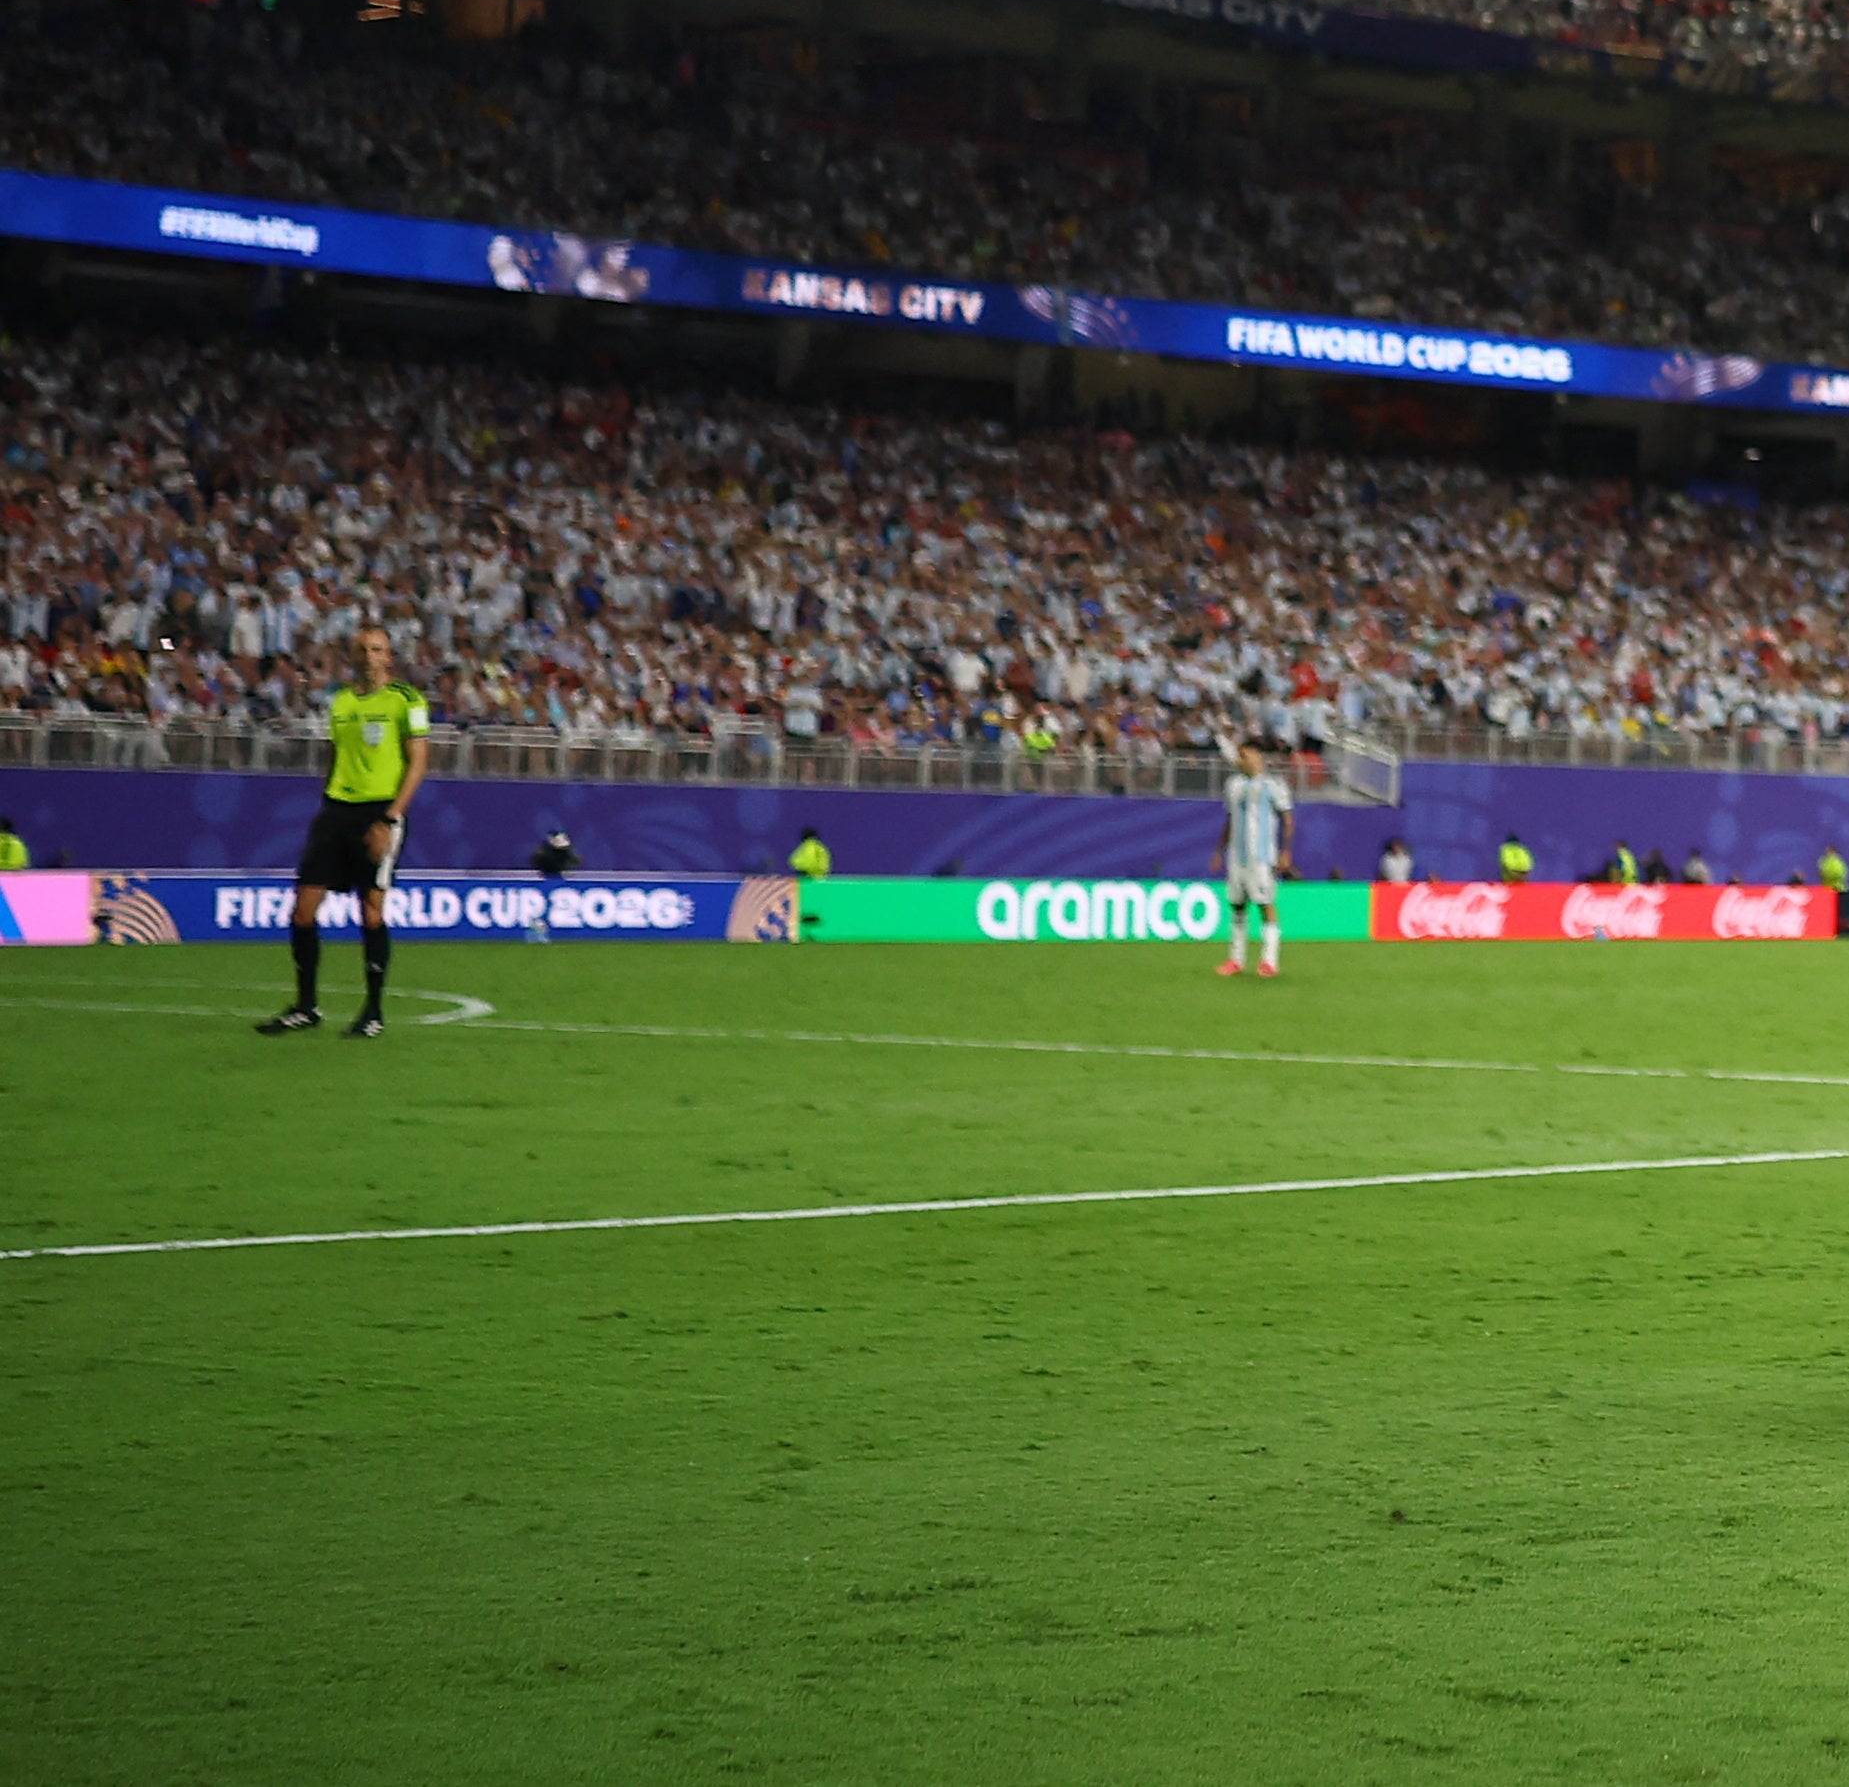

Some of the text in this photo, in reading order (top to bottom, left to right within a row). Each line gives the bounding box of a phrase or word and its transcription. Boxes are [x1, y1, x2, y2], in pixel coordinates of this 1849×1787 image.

[900, 284, 985, 326] CITY
[1227, 317, 1296, 358] FIFA
[1296, 324, 1405, 366] WORLD
[1407, 335, 1467, 373] CUP
[465, 887, 546, 929] CUP
[548, 887, 685, 930] 2026
[976, 880, 1220, 942] aramco
